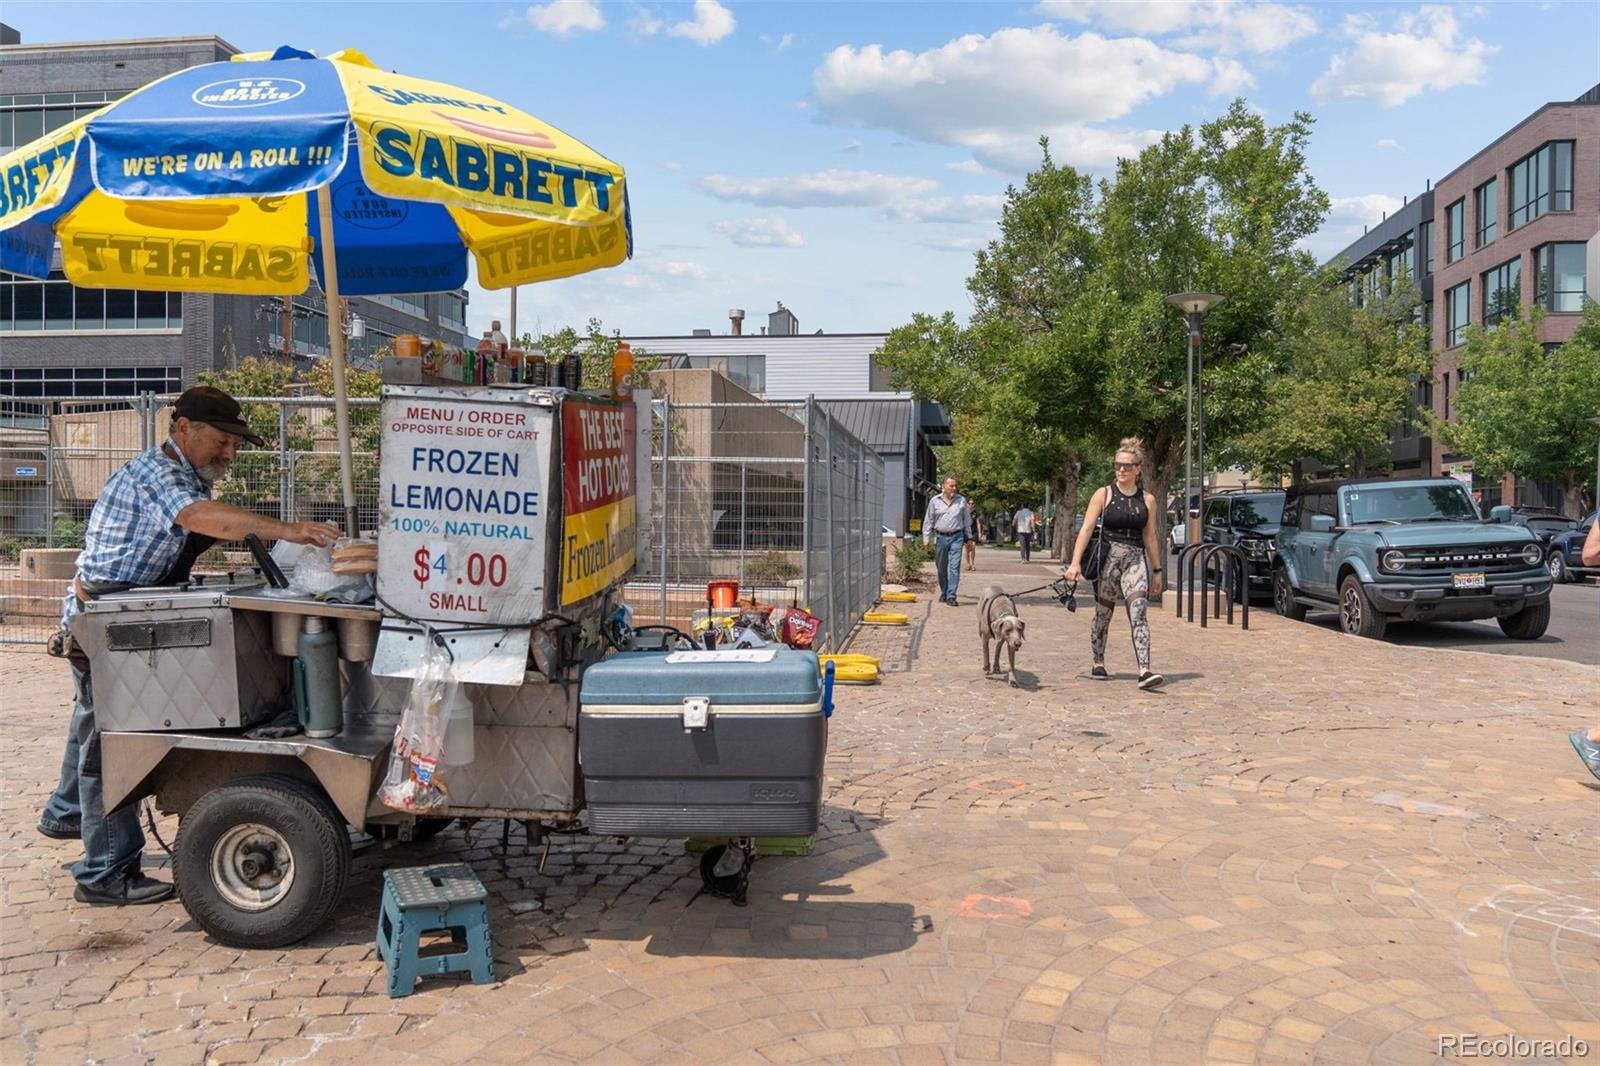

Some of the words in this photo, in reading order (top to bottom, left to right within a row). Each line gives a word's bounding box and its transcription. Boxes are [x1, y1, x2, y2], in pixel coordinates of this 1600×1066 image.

[367, 84, 507, 115] SABRETT
[123, 154, 188, 177] WE'RE
[194, 151, 223, 172] ON
[229, 150, 243, 170] A
[250, 147, 300, 169] ROLL
[373, 124, 616, 213] SABRETT
[407, 407, 454, 421] MENU
[468, 410, 526, 425] ORDER
[579, 409, 603, 451] THE
[603, 411, 625, 449] BEST
[392, 423, 453, 435] OPPOSITE
[456, 426, 485, 438] SIDE
[487, 428, 504, 438] OF
[507, 430, 540, 441] CART
[412, 447, 519, 477] FROZEN
[578, 458, 603, 503] HOT
[604, 453, 630, 496] DOGS
[391, 483, 538, 516] LEMONADE
[392, 517, 439, 534] 100%
[445, 521, 534, 540] NATURAL
[567, 533, 606, 584] Frozen
[1424, 553, 1508, 562] BRONCO
[429, 592, 487, 612] SMALL
